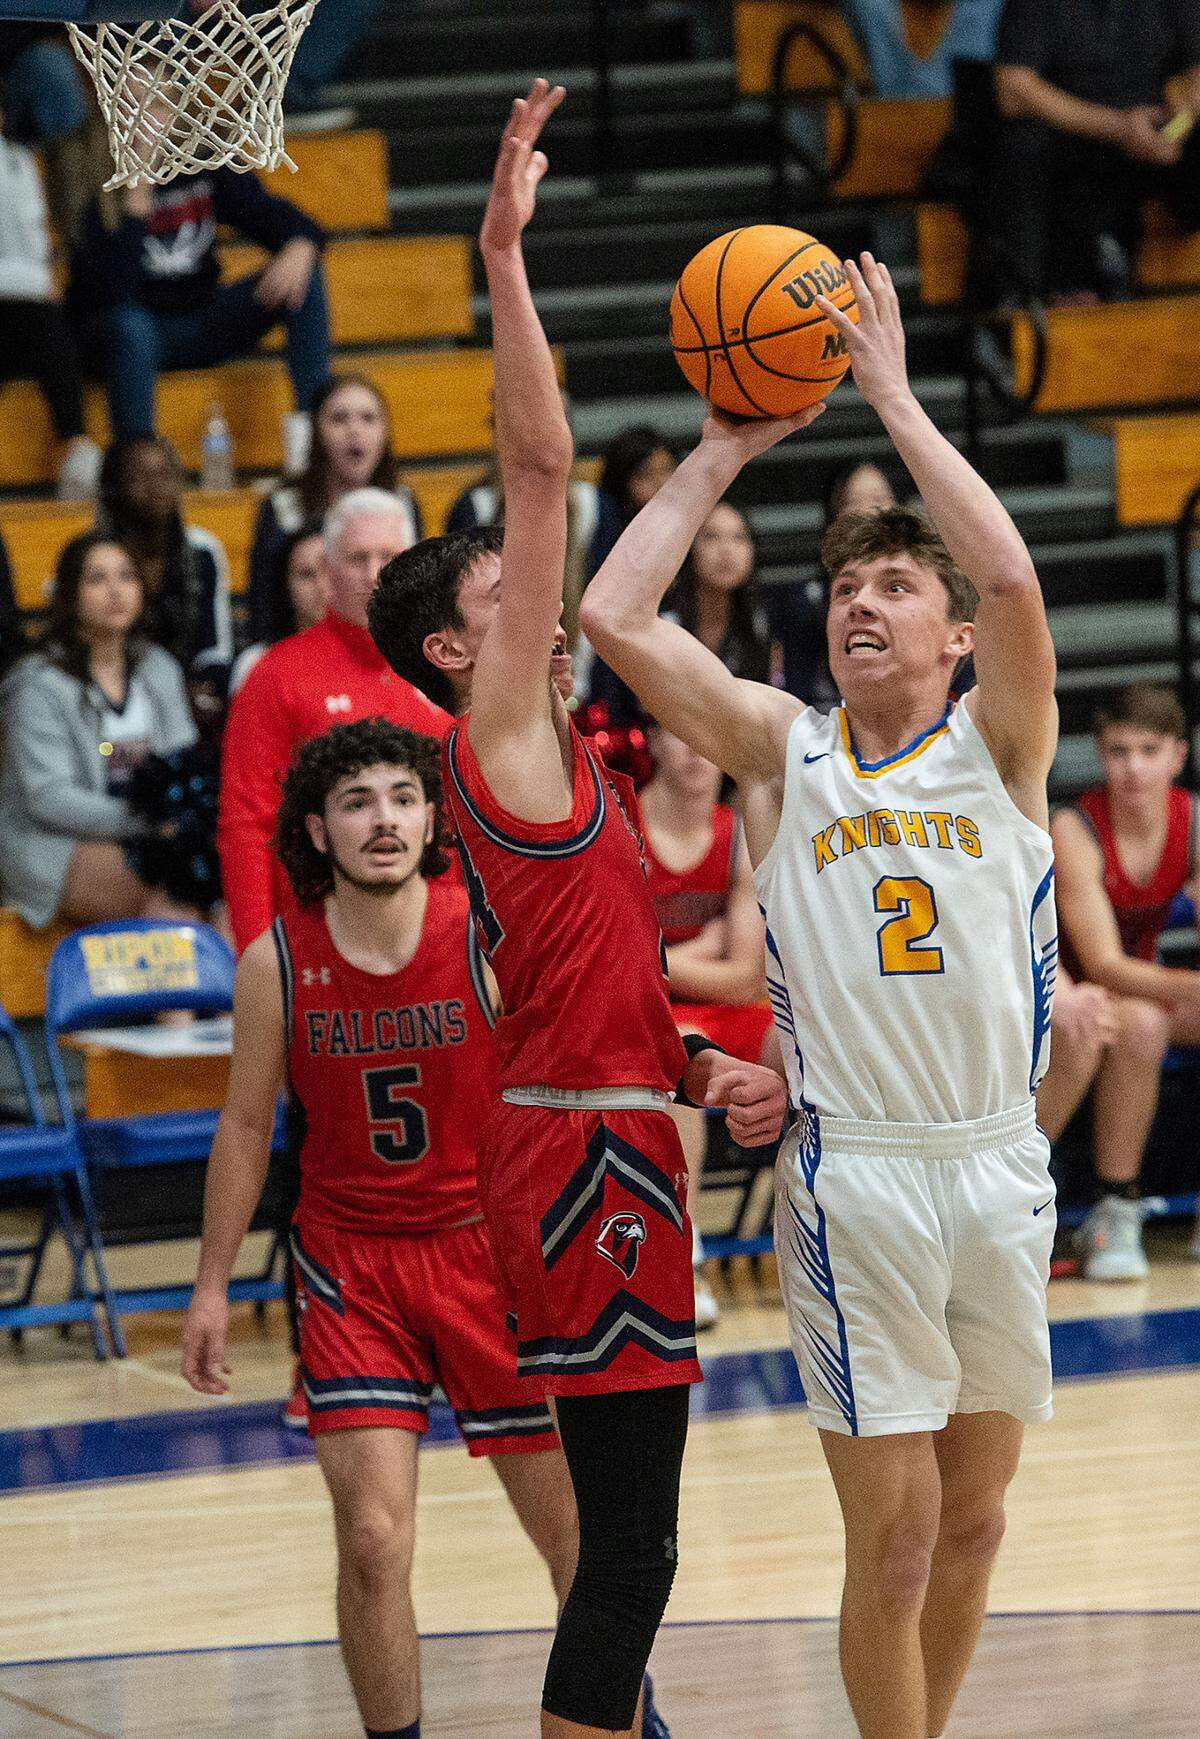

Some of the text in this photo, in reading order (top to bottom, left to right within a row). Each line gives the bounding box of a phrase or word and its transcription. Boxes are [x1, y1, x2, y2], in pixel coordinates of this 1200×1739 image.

[812, 808, 983, 874] KNIGHTS
[872, 875, 945, 976] 2
[305, 998, 468, 1057] FALCONS
[361, 1063, 430, 1165] 5
